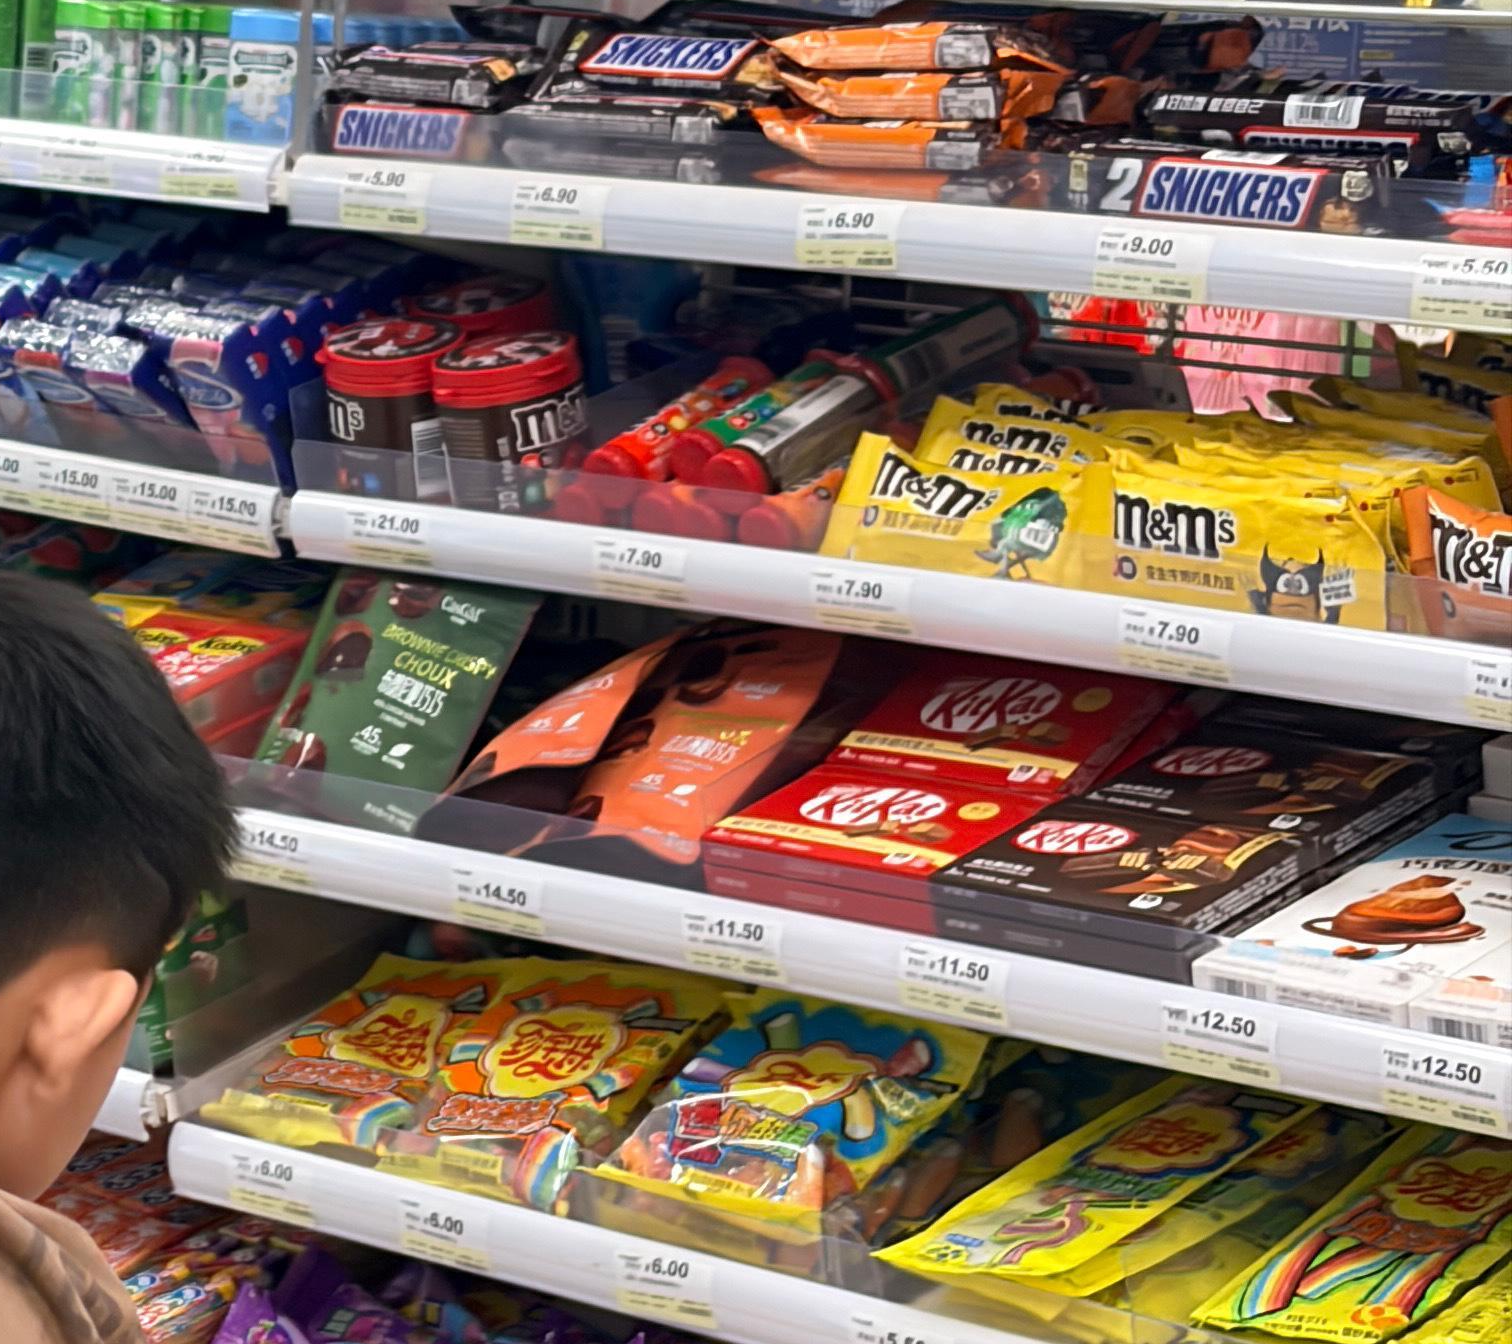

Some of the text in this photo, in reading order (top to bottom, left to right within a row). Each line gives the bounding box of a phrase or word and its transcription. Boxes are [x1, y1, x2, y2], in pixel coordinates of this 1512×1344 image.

[600, 36, 748, 74] SNICKERS
[338, 108, 463, 154] SNICKERS
[1100, 157, 1313, 224] 2 SNICKERS
[393, 650, 457, 690] CHOUX
[1413, 1056, 1481, 1084] ¥12.50
